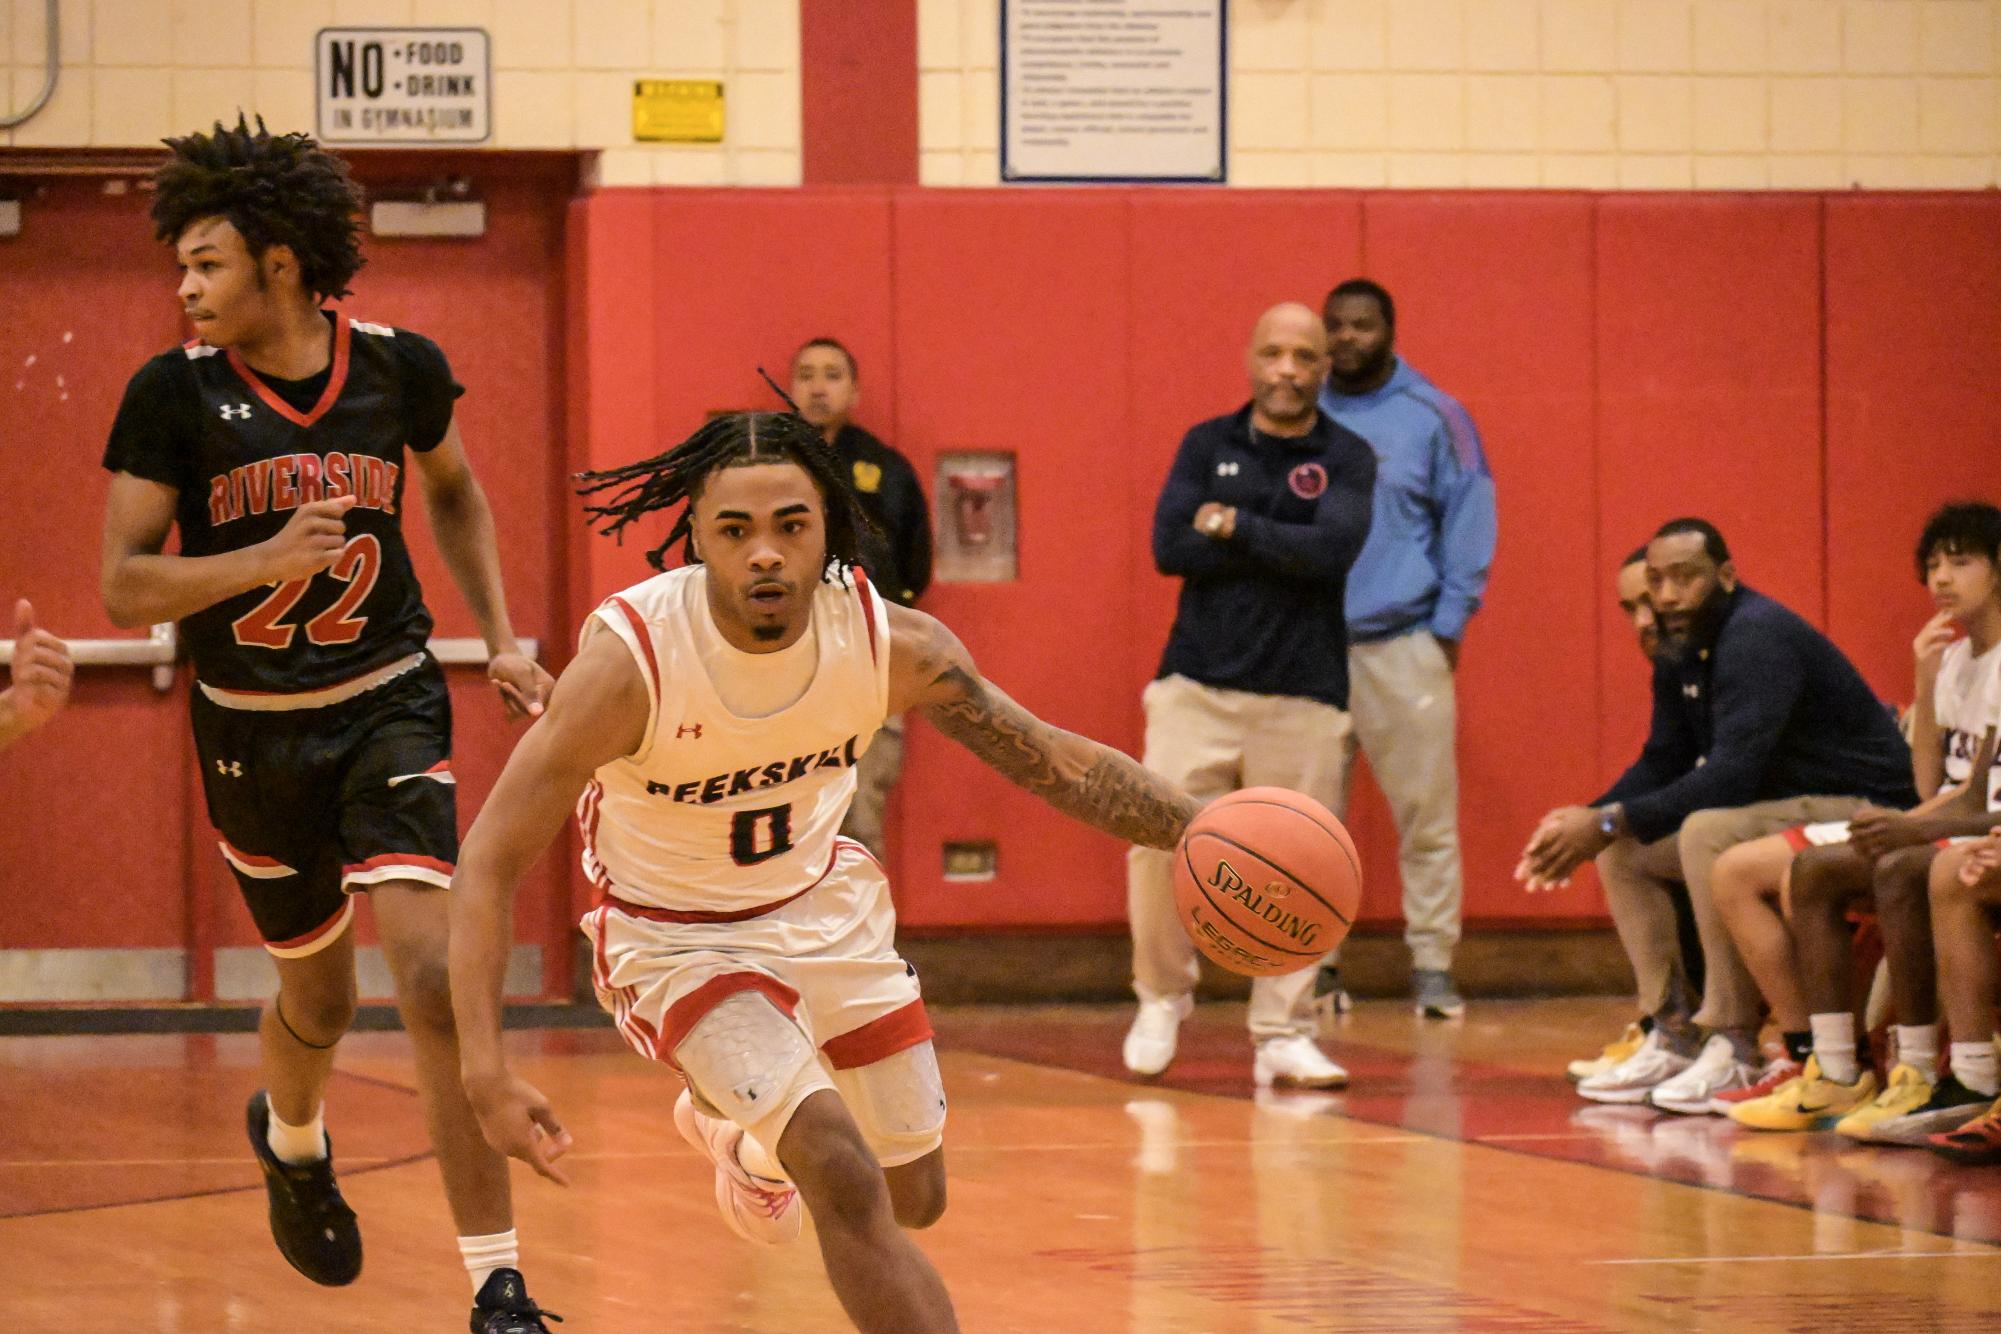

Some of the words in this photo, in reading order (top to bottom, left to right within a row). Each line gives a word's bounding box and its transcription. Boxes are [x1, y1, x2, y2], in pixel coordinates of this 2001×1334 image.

[331, 41, 383, 98] NO
[406, 42, 464, 65] FOOD
[407, 75, 475, 97] DRINK
[208, 452, 399, 527] RIVERSIDE
[232, 533, 381, 649] 22
[729, 802, 795, 868] 0
[1207, 859, 1322, 947] SPALDING
